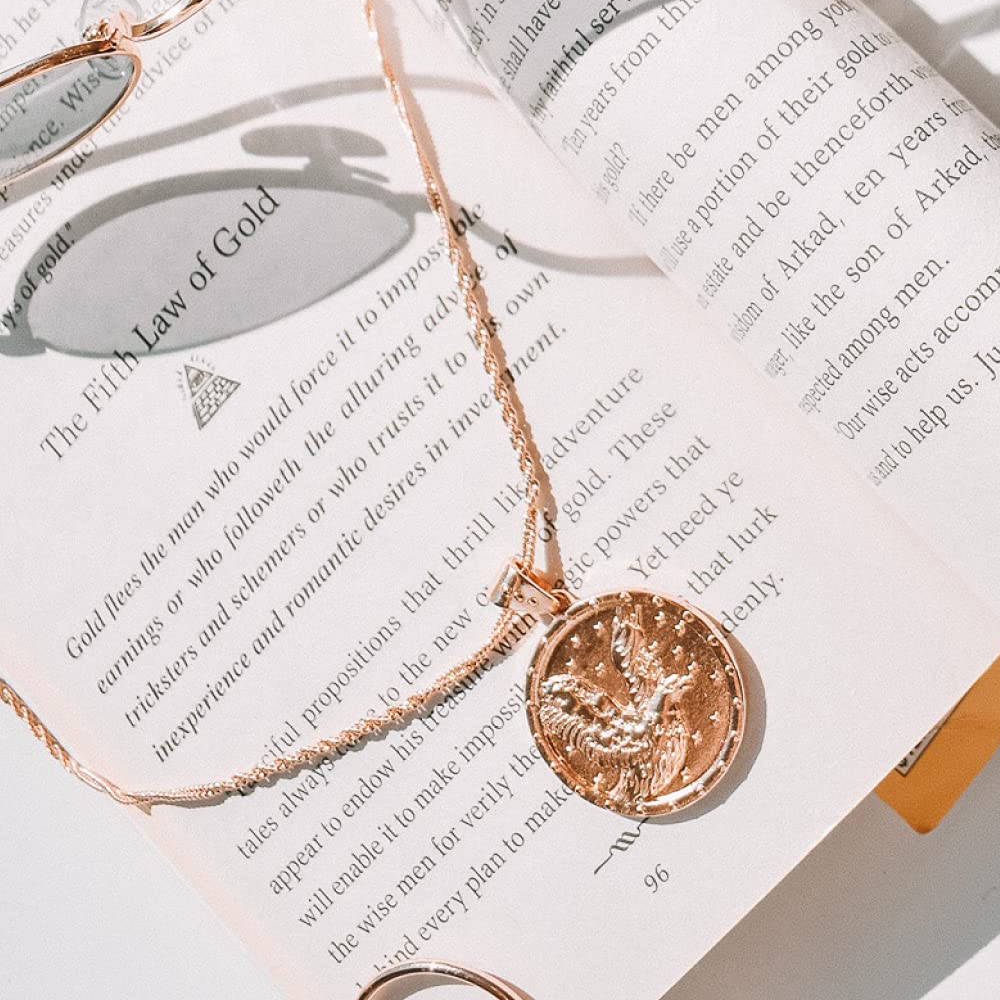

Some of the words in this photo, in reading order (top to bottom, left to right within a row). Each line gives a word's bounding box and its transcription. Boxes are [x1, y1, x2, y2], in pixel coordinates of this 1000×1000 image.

[134, 39, 193, 97] advice
[583, 80, 617, 136] years
[610, 32, 662, 85] from
[667, 142, 697, 170] be
[696, 91, 743, 141] men
[744, 19, 823, 91] among
[696, 150, 758, 227] portion
[756, 117, 782, 151] of
[778, 70, 835, 126] their
[836, 33, 880, 79] gold
[731, 215, 765, 258] and
[757, 189, 791, 219] be
[790, 71, 914, 187] thenceforth
[760, 272, 781, 302] of
[776, 211, 847, 281] Arkad,
[843, 168, 887, 206] ten
[889, 110, 947, 169] years
[781, 315, 817, 350] like
[810, 283, 846, 318] the
[845, 244, 885, 284] son
[887, 207, 913, 240] of
[914, 144, 989, 214] Arkad,
[40, 410, 88, 460] The
[81, 349, 140, 413] Fifth
[132, 289, 188, 351] Law
[189, 252, 217, 291] of
[213, 184, 281, 257] Gold
[838, 305, 901, 369] among
[893, 258, 950, 309] men.
[861, 379, 900, 418] wise
[896, 341, 935, 384] acts
[65, 609, 106, 660] Gold
[104, 573, 142, 620] flees
[140, 543, 168, 576] the
[167, 500, 205, 545] man
[205, 460, 240, 500] who
[239, 395, 293, 460] would
[290, 351, 338, 406] force
[96, 616, 164, 694] earnings
[188, 549, 223, 589] who
[223, 457, 301, 550] followeth
[304, 421, 337, 457] the
[341, 335, 422, 419] alluring
[125, 645, 198, 728] tricksters
[199, 603, 231, 647] and
[231, 523, 306, 610] schemers
[327, 455, 368, 499] who
[368, 394, 424, 455] trusts
[506, 271, 550, 316] own
[902, 402, 950, 446] help
[152, 652, 250, 763] inexperience
[252, 610, 285, 656] and
[284, 528, 362, 618] romantic
[363, 462, 427, 531] desires
[424, 438, 450, 463] in
[301, 615, 401, 729] propositions
[401, 571, 443, 614] that
[442, 512, 496, 570] thrill
[542, 367, 644, 471] adventure
[399, 651, 432, 686] the
[432, 609, 473, 652] new
[561, 468, 612, 523] gold.
[609, 401, 677, 463] These
[237, 816, 279, 860] tales
[278, 756, 336, 820] always
[593, 478, 667, 560] powers
[664, 434, 712, 480] that
[270, 833, 326, 895] appear
[341, 759, 396, 818] endow
[390, 729, 423, 761] his
[629, 546, 669, 582] Yet
[663, 493, 719, 549] heed
[299, 889, 334, 928] will
[331, 838, 384, 895] enable
[394, 807, 416, 829] to
[413, 761, 462, 811] make
[687, 549, 733, 596] that
[728, 503, 779, 552] lurk
[327, 934, 359, 964] the
[357, 895, 398, 935] wise
[396, 856, 436, 897] men
[431, 828, 462, 857] for
[460, 776, 512, 829] verily
[418, 890, 469, 942] every
[464, 851, 507, 899] plan
[502, 831, 525, 854] to
[644, 863, 670, 893] 96
